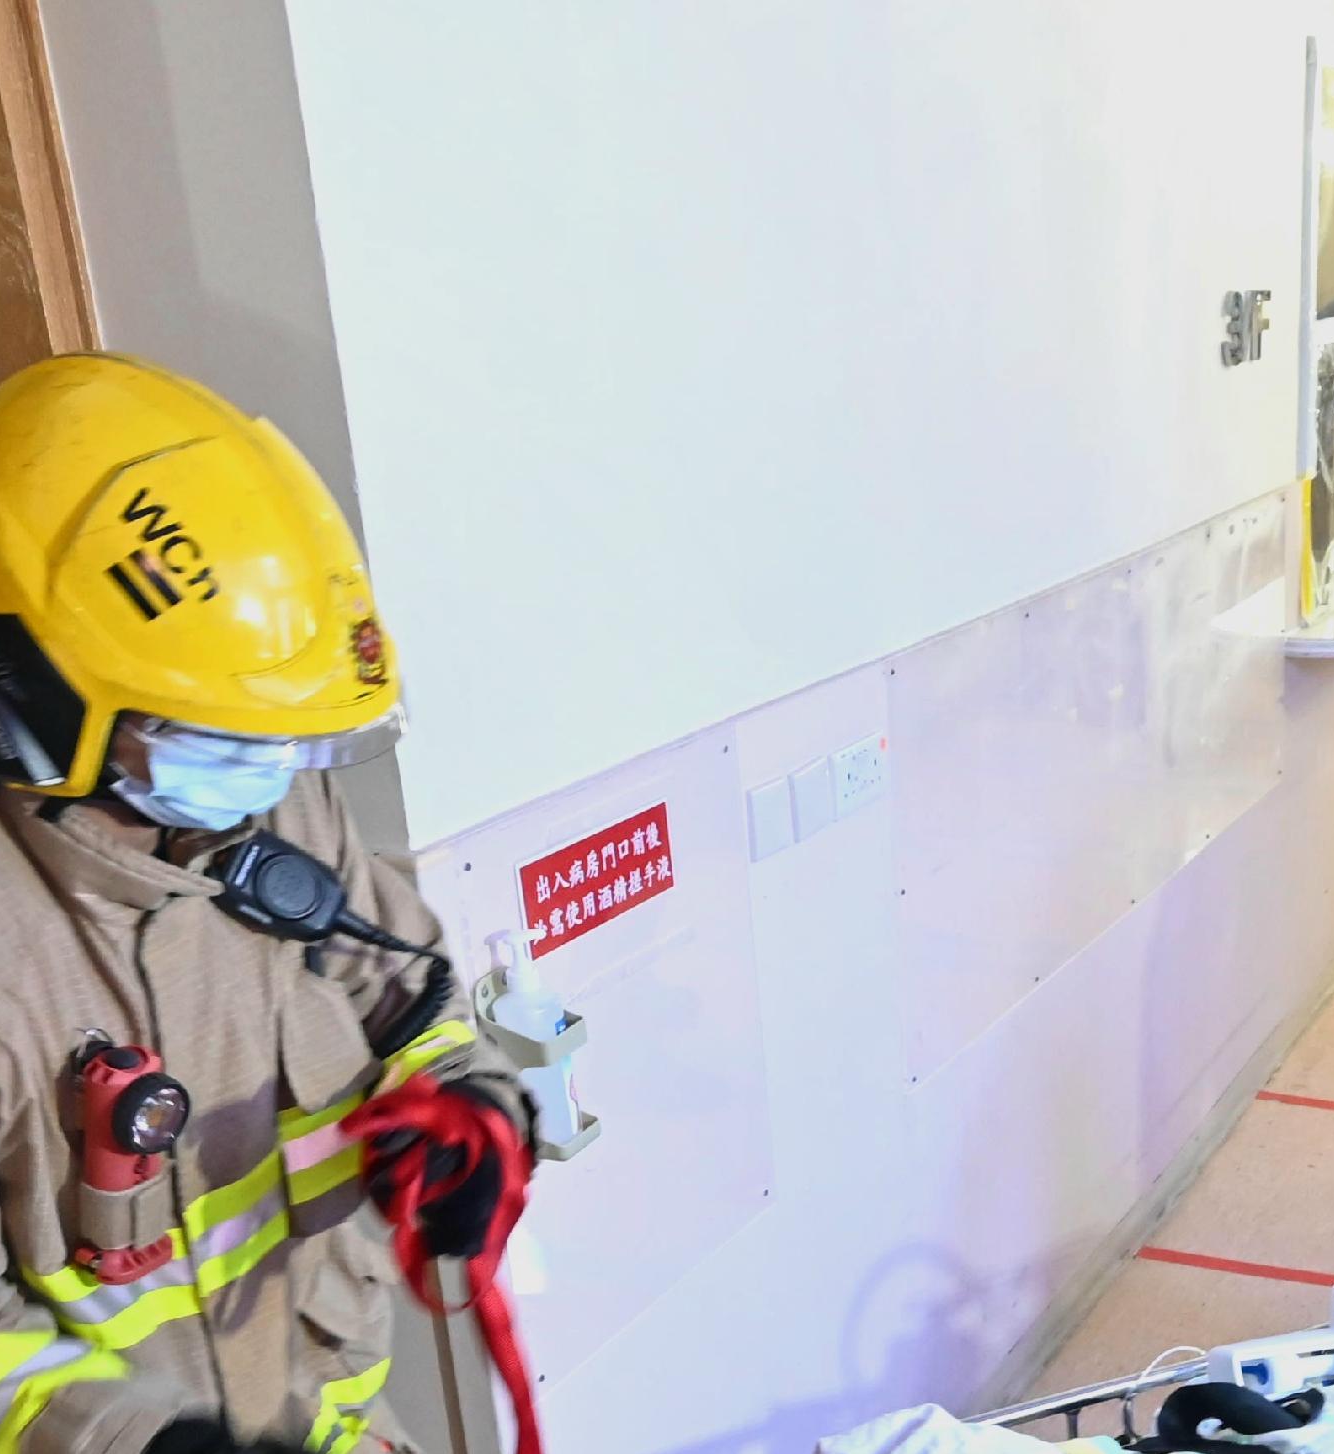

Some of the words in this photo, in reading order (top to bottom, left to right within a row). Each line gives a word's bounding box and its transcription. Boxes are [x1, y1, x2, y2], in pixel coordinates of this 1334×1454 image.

[1220, 289, 1271, 367] 3F
[536, 821, 662, 903] 出入病房門口前後
